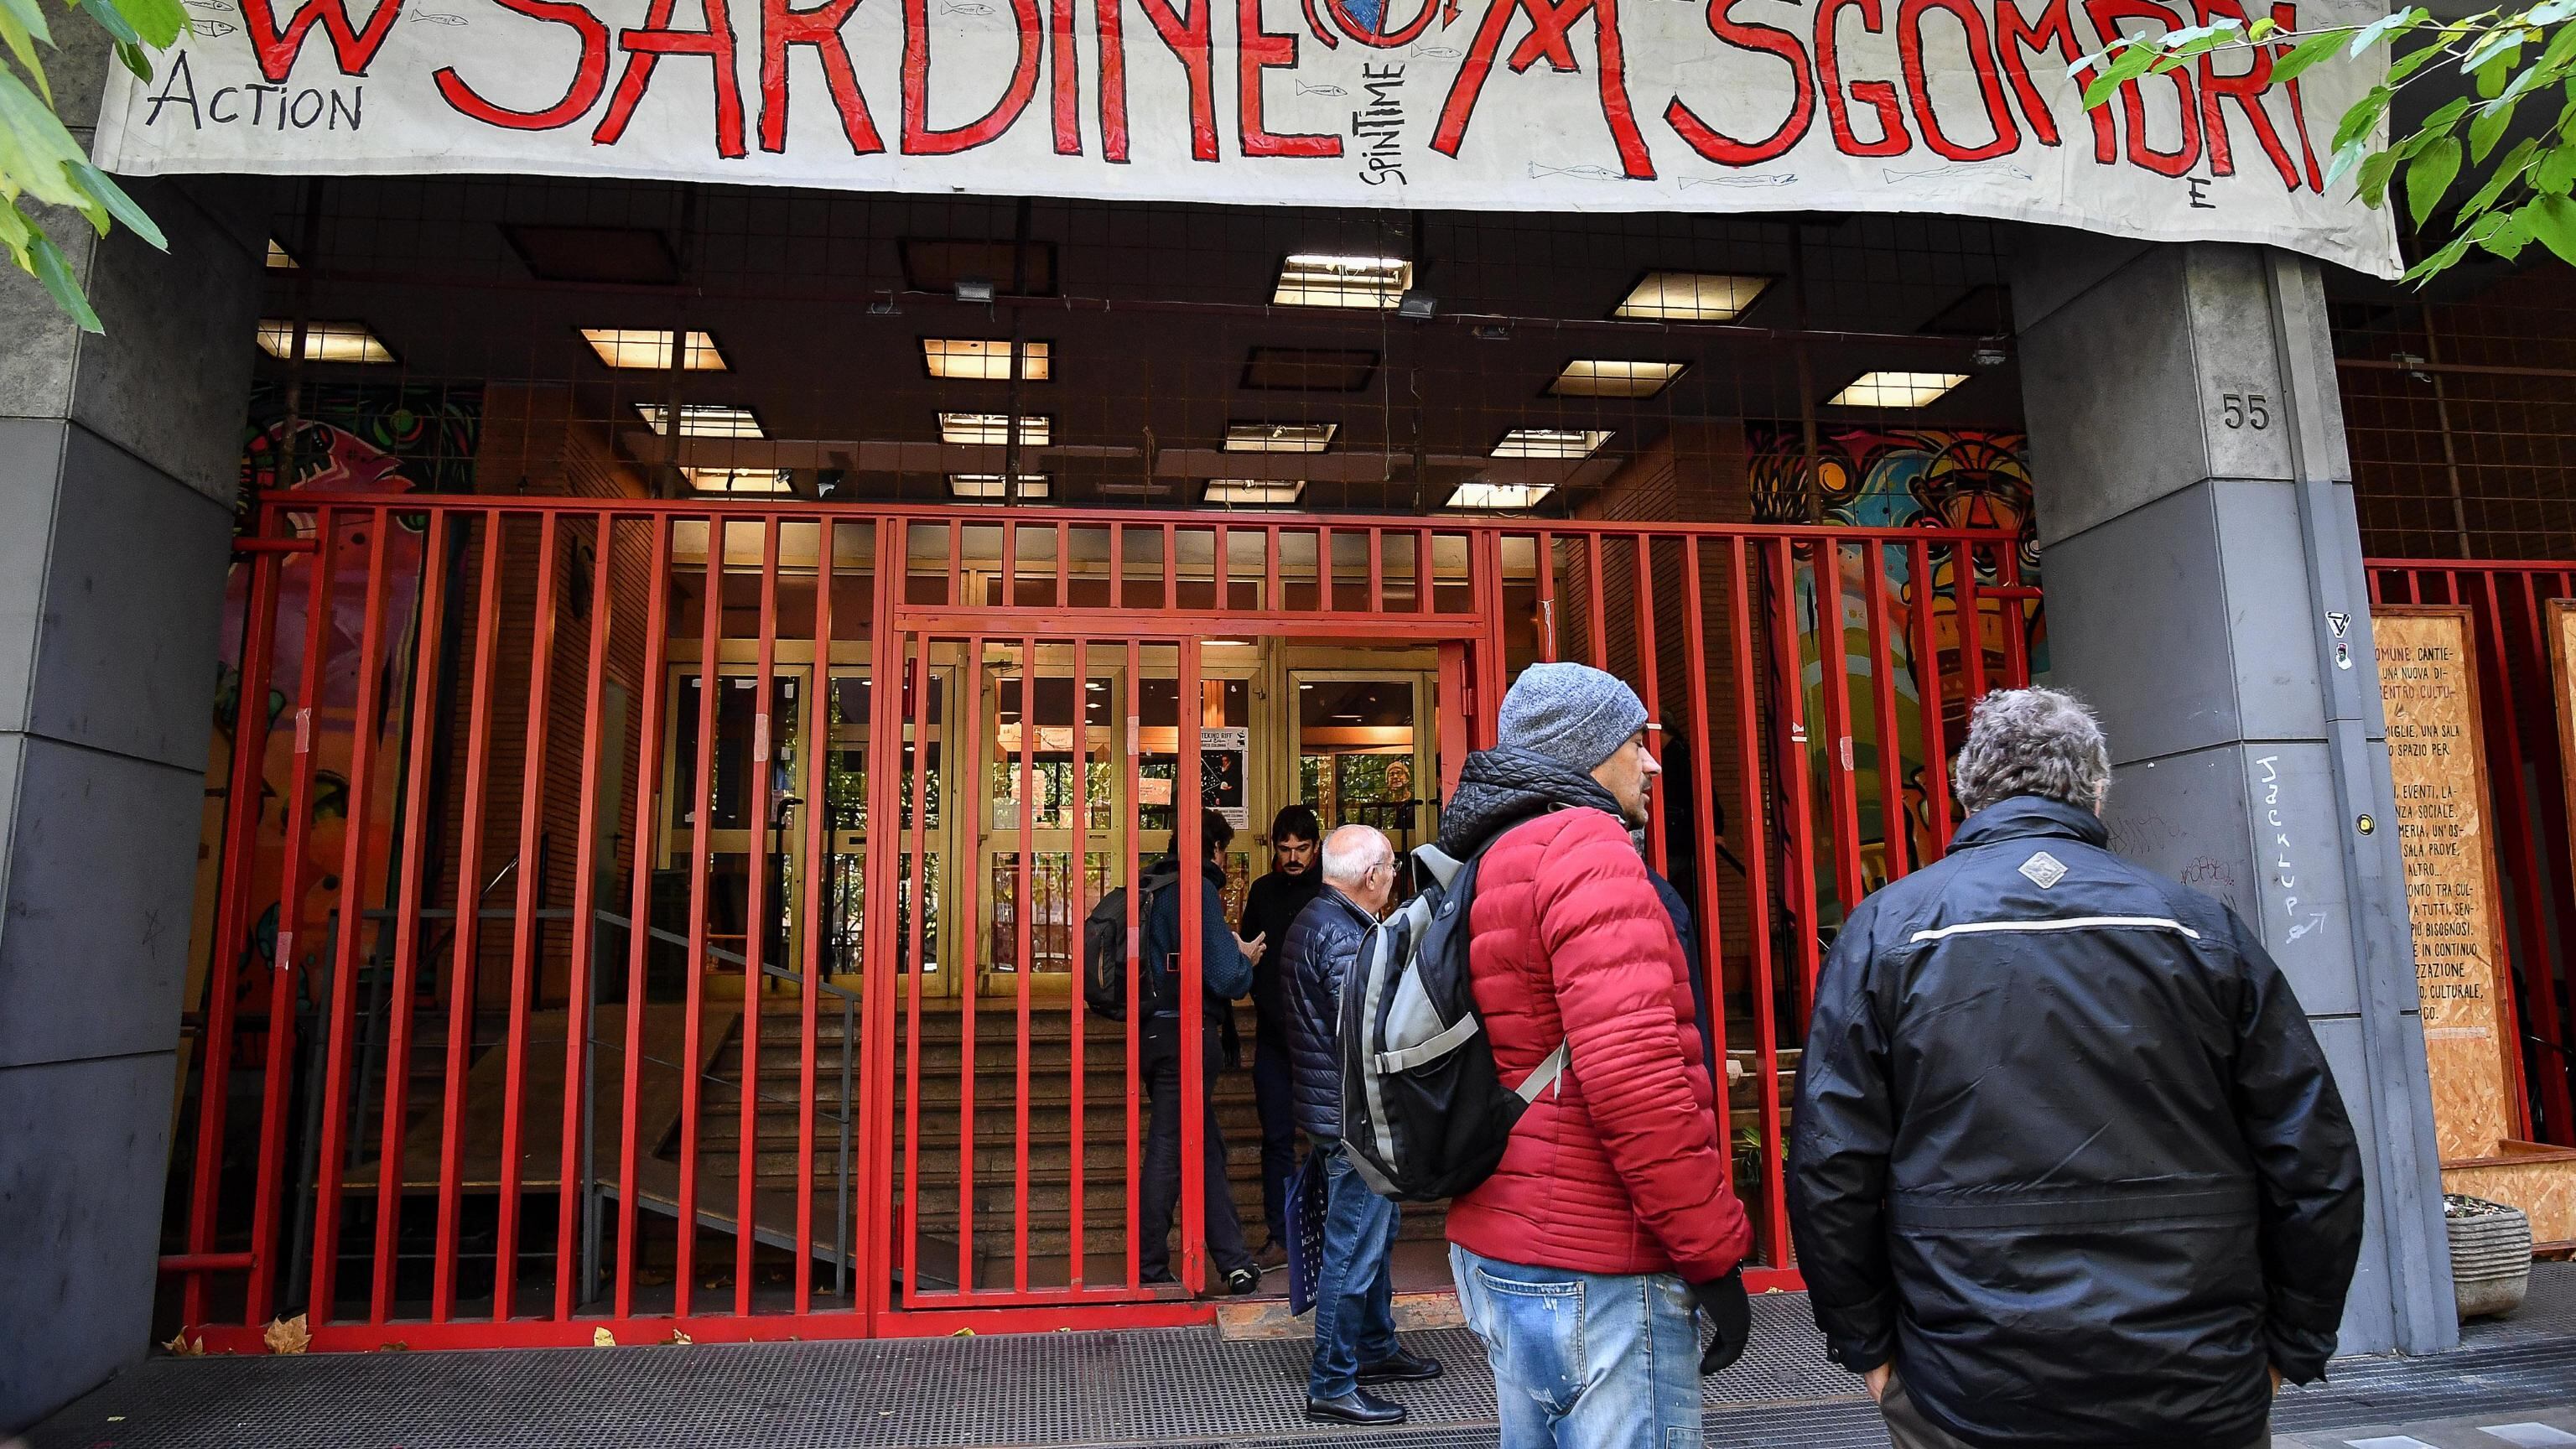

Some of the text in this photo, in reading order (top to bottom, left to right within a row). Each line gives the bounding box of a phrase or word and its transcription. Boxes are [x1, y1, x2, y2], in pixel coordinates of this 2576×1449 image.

[2186, 176, 2216, 209] E
[2223, 393, 2269, 429] 55
[2418, 647, 2454, 662] CANTIE-
[2382, 667, 2449, 680] UNA NUOVA DI-
[2380, 685, 2456, 700] ENTRO CULTU-
[2421, 725, 2438, 737] UNA
[2442, 725, 2460, 737] SALA
[2398, 745, 2428, 756] SPAZIO
[2432, 743, 2450, 756] PER
[2442, 786, 2458, 799] LA-
[2403, 844, 2424, 857] SALA
[2406, 884, 2473, 896] ONTO TRA CUL-
[2414, 905, 2419, 916] A
[2454, 903, 2474, 916] SEN-
[2422, 943, 2431, 957] IN
[2434, 943, 2477, 957] CONTINUO
[2430, 984, 2484, 1000] CULTURALE,
